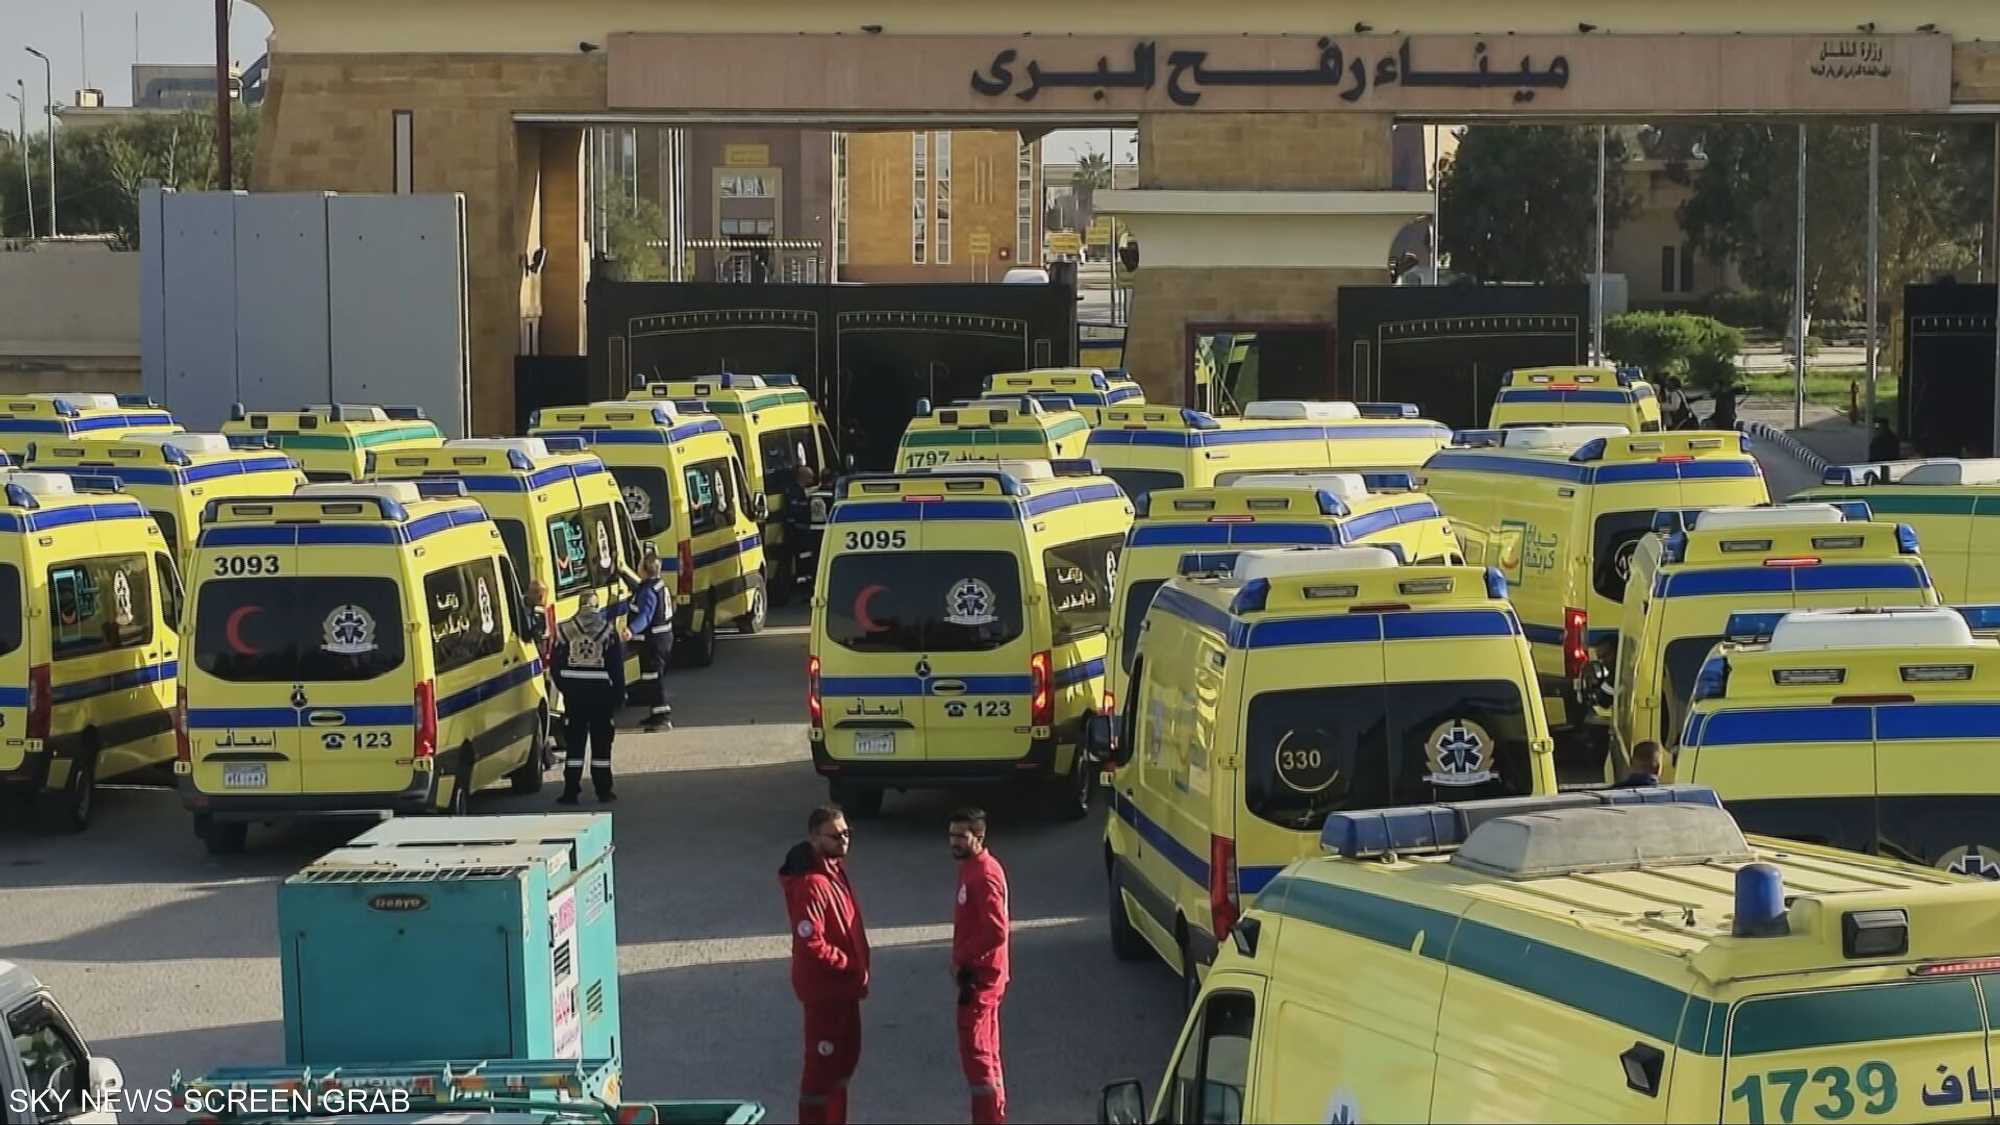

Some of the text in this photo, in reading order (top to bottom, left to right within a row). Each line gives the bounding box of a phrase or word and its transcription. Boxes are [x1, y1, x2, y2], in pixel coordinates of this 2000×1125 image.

[1167, 37, 1366, 106] رفح
[1374, 38, 1569, 102] ميناء
[907, 449, 950, 468] 1797
[845, 531, 906, 549] 3095
[214, 555, 279, 576] 3093
[974, 701, 1011, 717] 123
[353, 732, 392, 749] 123
[1283, 750, 1321, 770] 330
[1731, 1060, 1898, 1124] 1739
